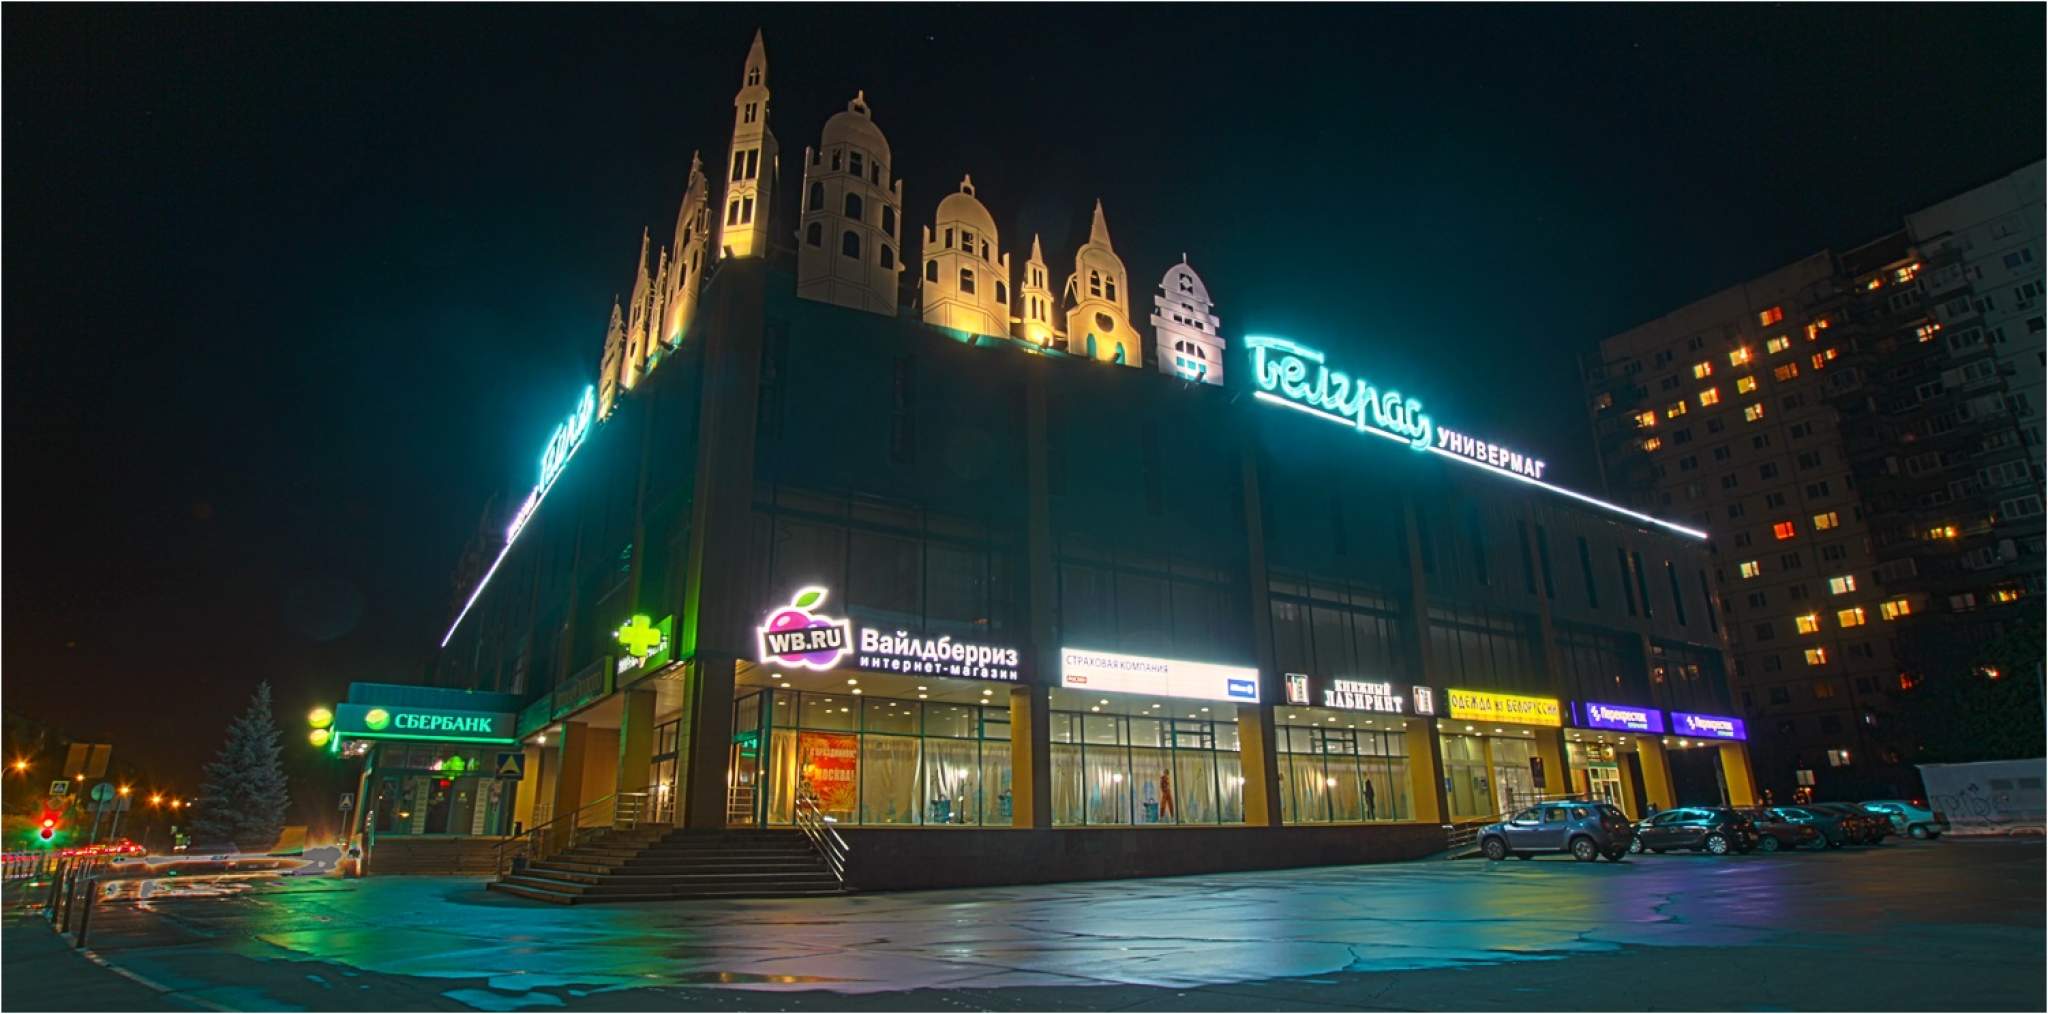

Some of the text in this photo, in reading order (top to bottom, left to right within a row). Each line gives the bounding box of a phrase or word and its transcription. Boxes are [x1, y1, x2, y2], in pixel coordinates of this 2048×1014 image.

[1437, 426, 1546, 479] УНИВЕРМАГ
[769, 629, 841, 654] WB.RU
[861, 627, 1019, 668] Вайлдберриз
[859, 656, 1018, 680] интернет-магазин
[1066, 655, 1169, 674] СТРАХОВАЯ КОМПАНИЯ
[1334, 679, 1392, 696] КНИЖНЫЙ
[1324, 690, 1403, 713] ЛАБИРИНТ
[1452, 694, 1491, 711] ОДЕЖДА
[394, 713, 492, 733] СБЕРБАНК
